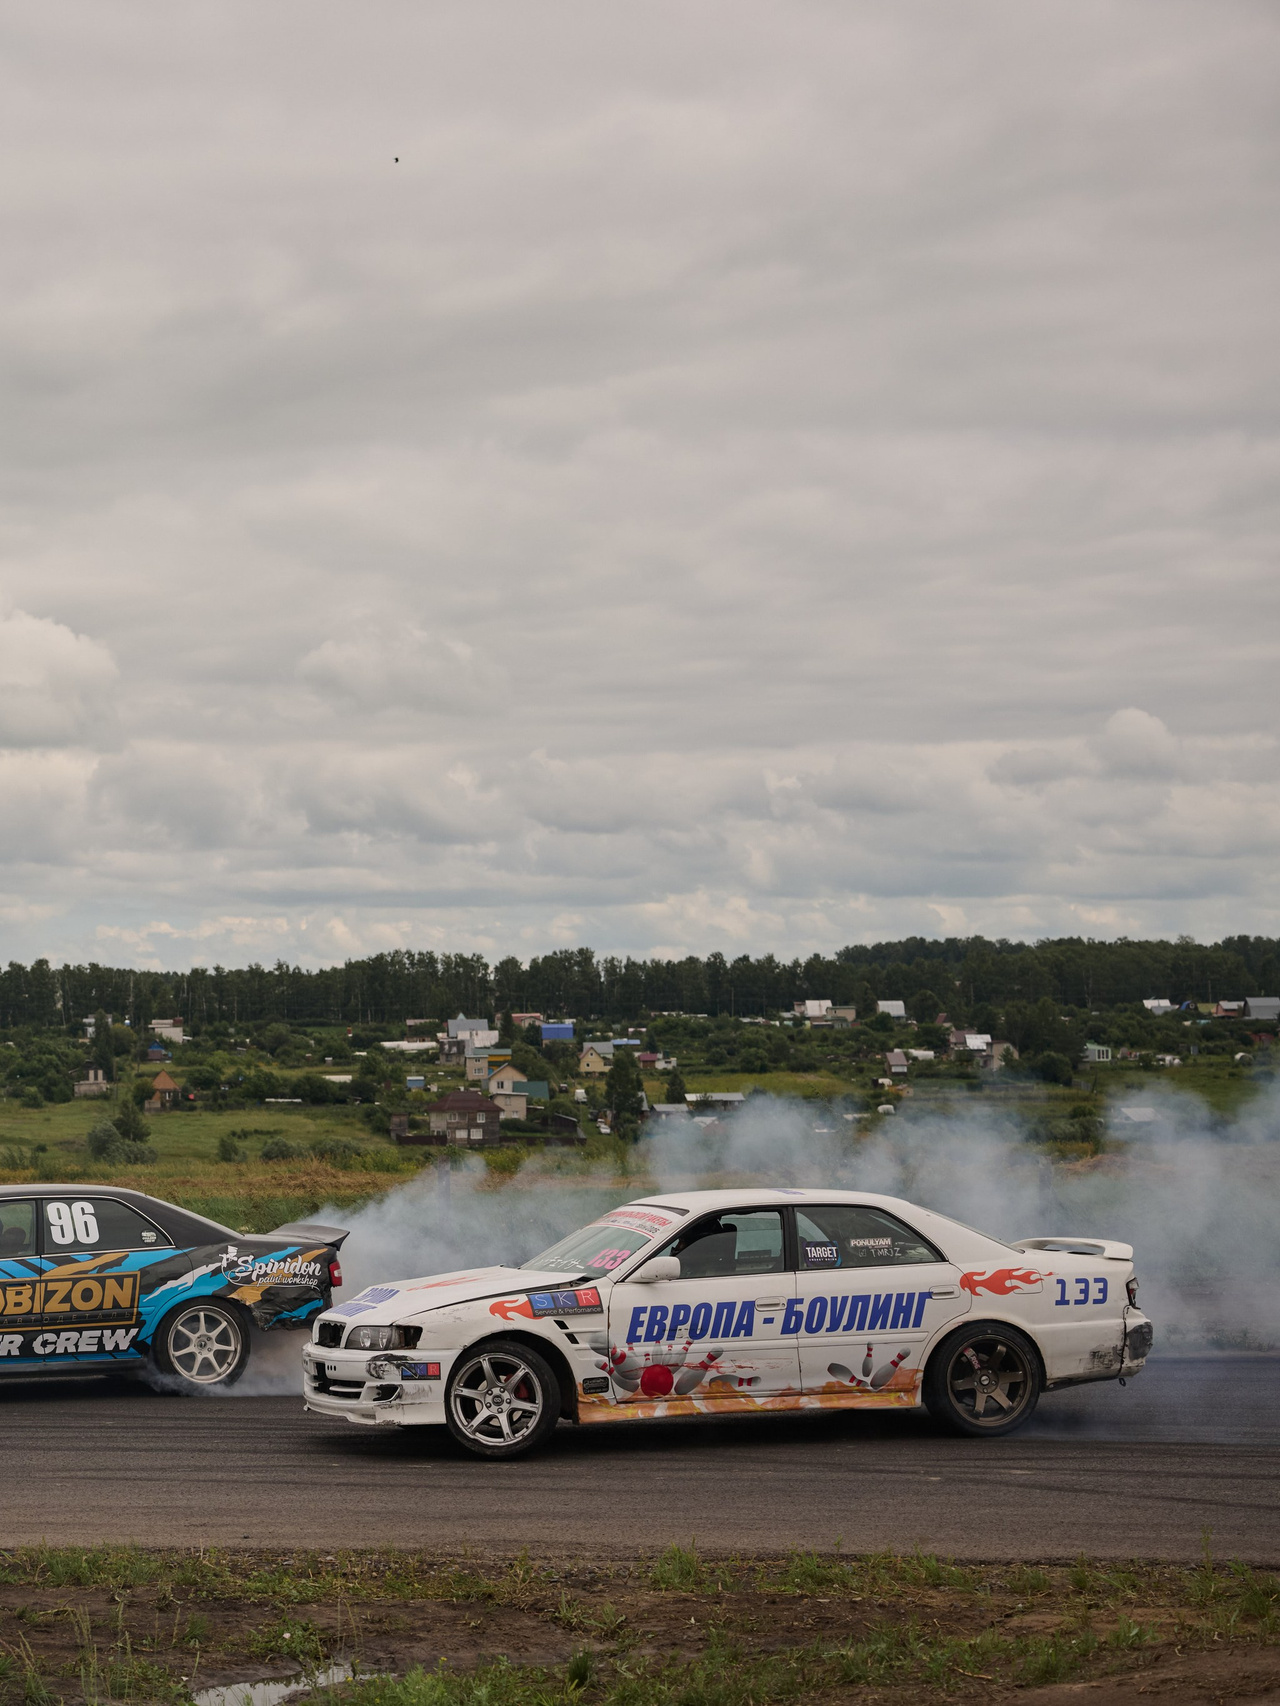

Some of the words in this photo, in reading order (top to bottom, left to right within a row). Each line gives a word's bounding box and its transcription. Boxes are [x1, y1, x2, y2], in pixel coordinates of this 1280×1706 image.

[46, 1201, 100, 1245] 96
[586, 1248, 631, 1270] 133
[805, 1246, 837, 1258] TARGET
[234, 1255, 322, 1282] Spiridon
[256, 1274, 281, 1287] paint
[282, 1274, 318, 1289] workshop
[3, 1277, 134, 1315] BIZON
[534, 1290, 595, 1307] SKR
[1055, 1277, 1108, 1306] 133
[2, 1311, 131, 1326] АВТОДЕТАЛЬ
[626, 1300, 756, 1344] ЕВРОПА
[780, 1291, 934, 1335] БОУЛИНГ
[33, 1328, 139, 1355] CREW
